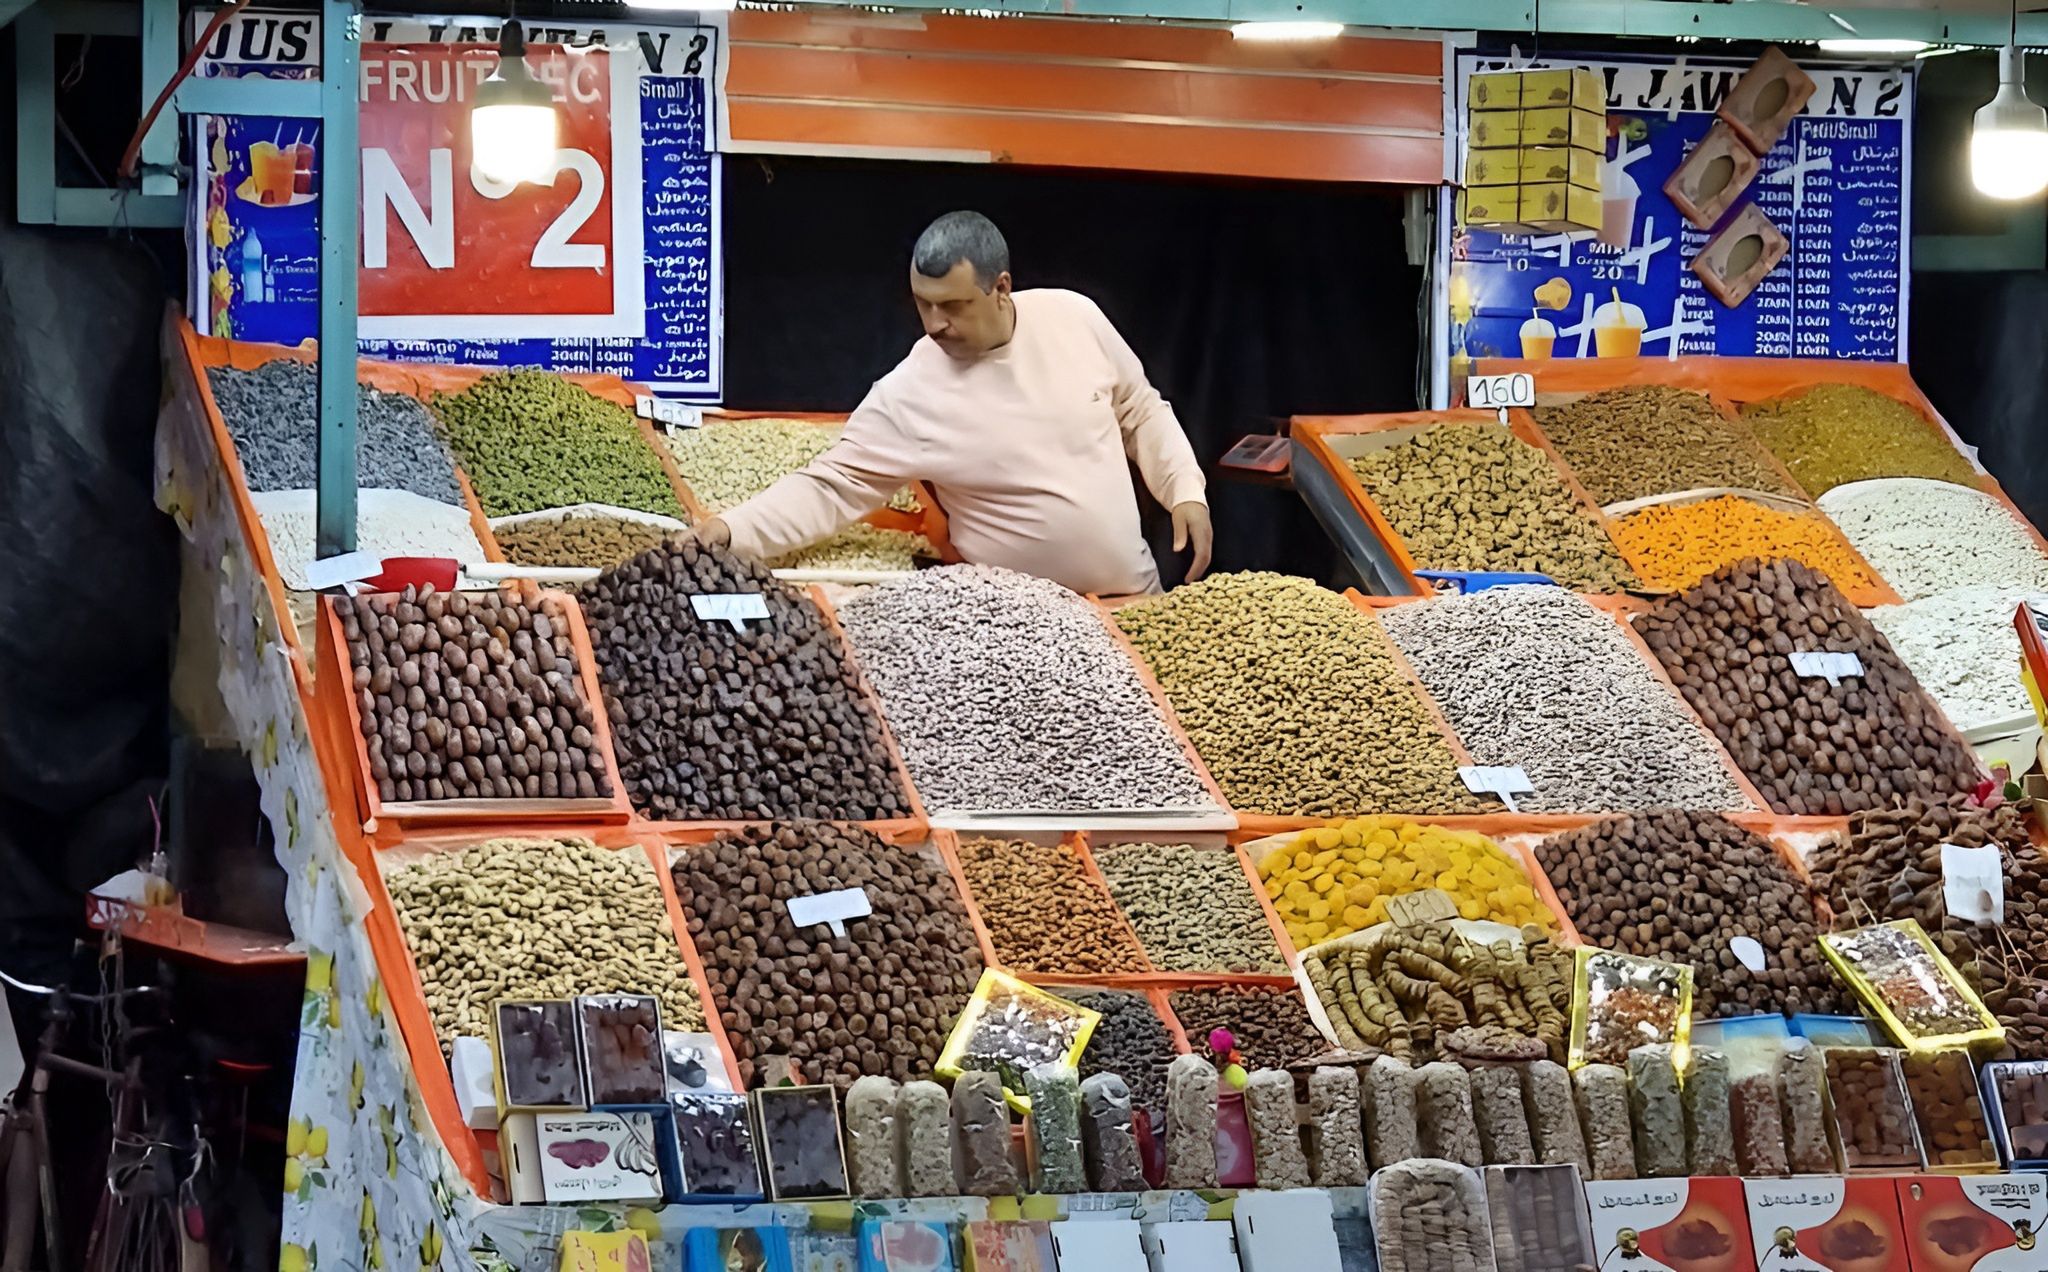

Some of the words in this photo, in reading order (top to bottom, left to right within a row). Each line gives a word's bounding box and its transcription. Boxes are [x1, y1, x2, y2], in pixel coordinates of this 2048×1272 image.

[205, 19, 312, 61] JUS
[682, 33, 708, 74] 2
[360, 60, 496, 103] FRUIT
[1826, 76, 1862, 114] N
[1874, 78, 1903, 117] 2
[1506, 257, 1529, 272] 10
[1592, 265, 1623, 280] 20
[1474, 373, 1529, 405] 160
